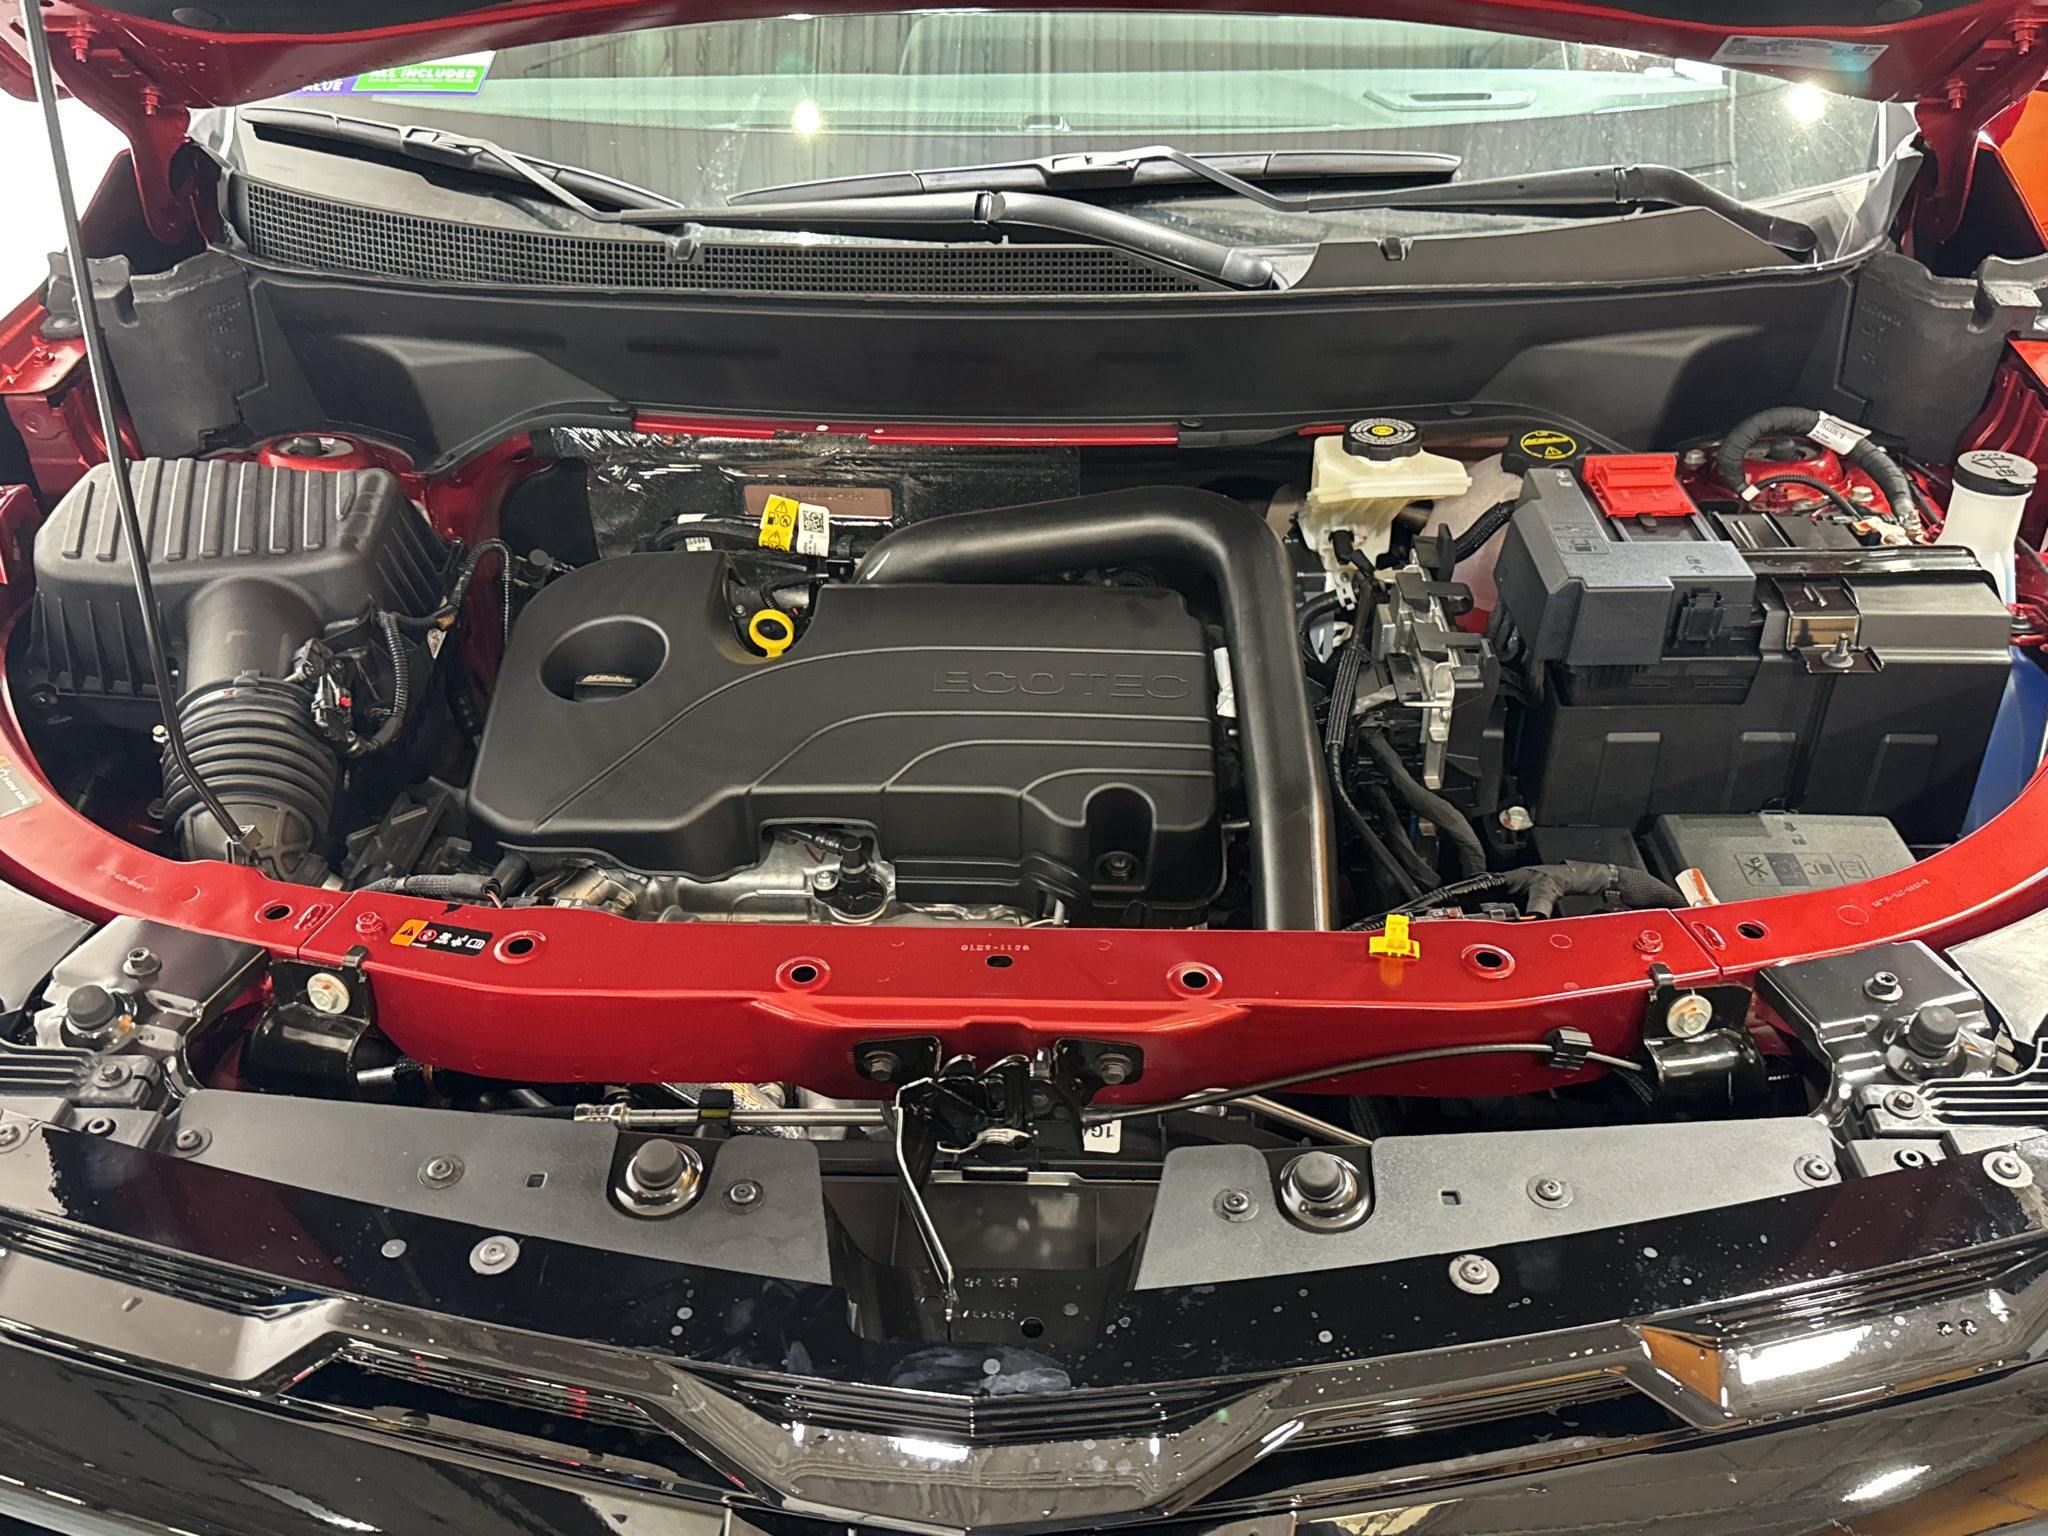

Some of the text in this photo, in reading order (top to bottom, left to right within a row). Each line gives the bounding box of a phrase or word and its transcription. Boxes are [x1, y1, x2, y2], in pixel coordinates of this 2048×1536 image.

[369, 68, 477, 79] ALL INCLUDED
[581, 674, 633, 684] ACDelco
[933, 668, 1189, 699] ECOTEC
